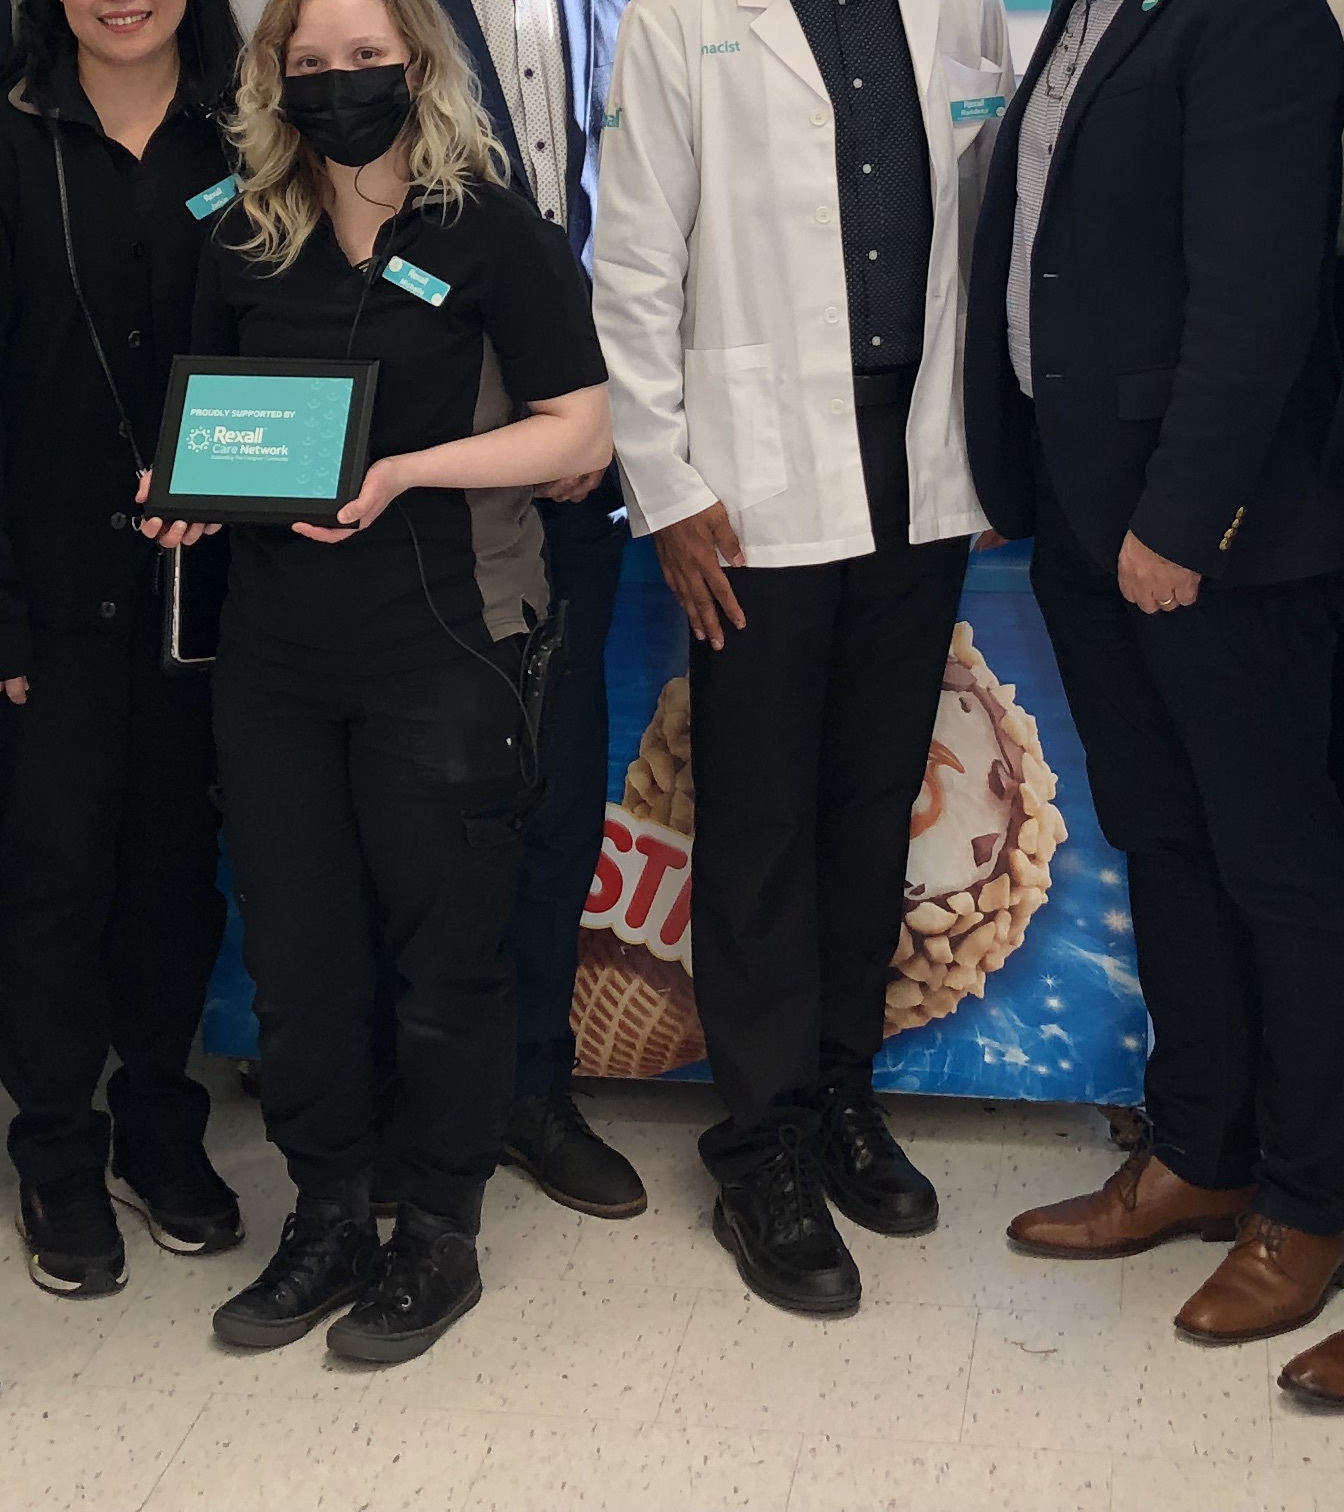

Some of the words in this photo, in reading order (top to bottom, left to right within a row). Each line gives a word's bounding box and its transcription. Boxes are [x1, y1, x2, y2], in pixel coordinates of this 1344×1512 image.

[190, 408, 231, 417] PROUDLY
[231, 409, 283, 419] SUPPORTED
[283, 410, 296, 419] BY
[213, 426, 264, 445] Rexall
[212, 443, 239, 455] Care
[240, 444, 289, 456] Network
